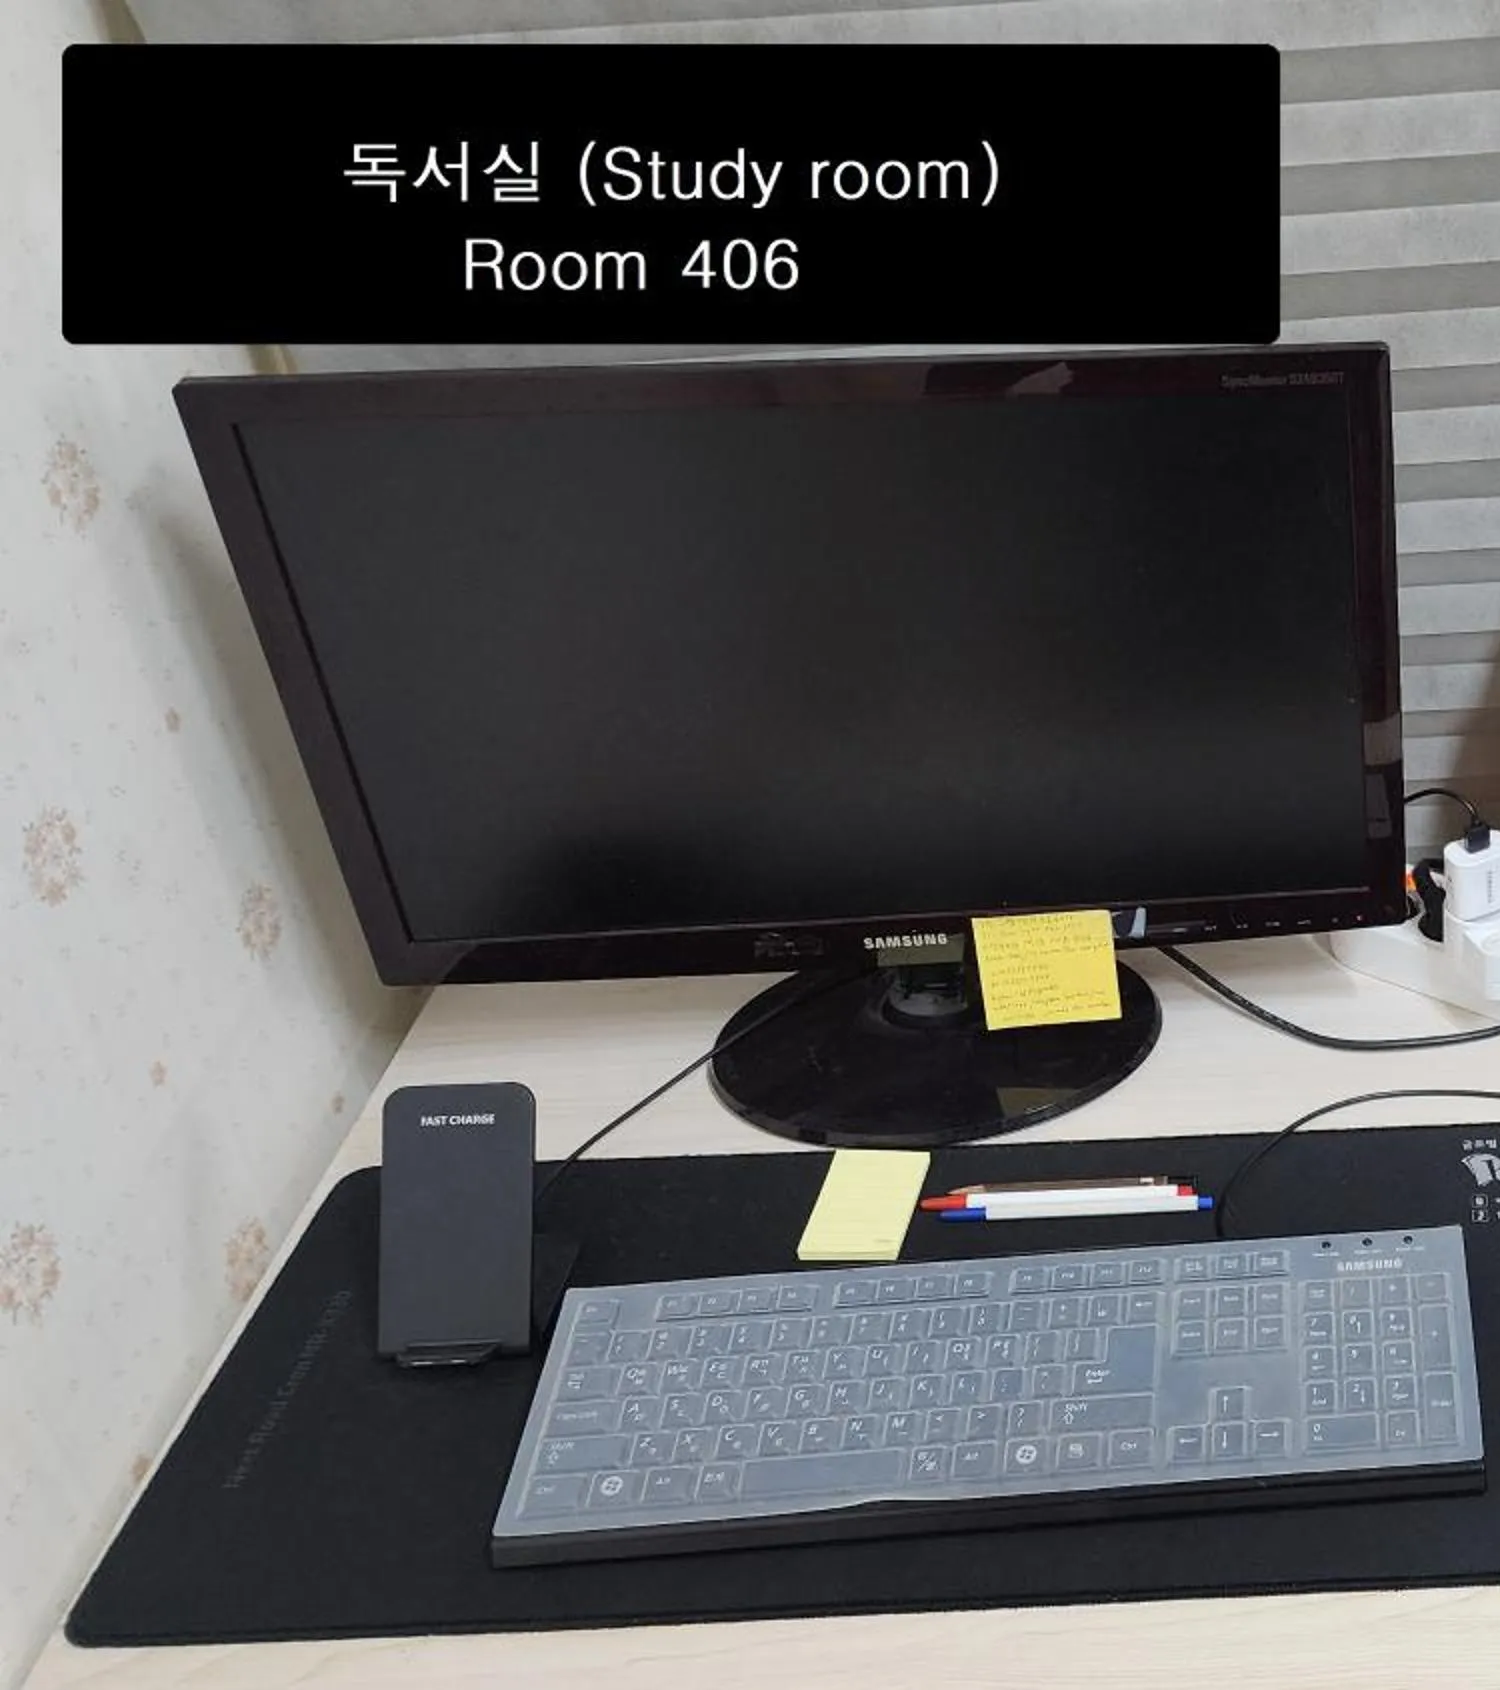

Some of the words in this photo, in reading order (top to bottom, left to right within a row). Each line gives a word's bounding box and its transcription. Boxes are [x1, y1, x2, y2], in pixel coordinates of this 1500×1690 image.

[864, 933, 948, 950] SAMSUNG
[420, 1115, 448, 1127] FAST
[449, 1113, 496, 1126] CHARGE
[1337, 1257, 1402, 1272] SAMSUNG
